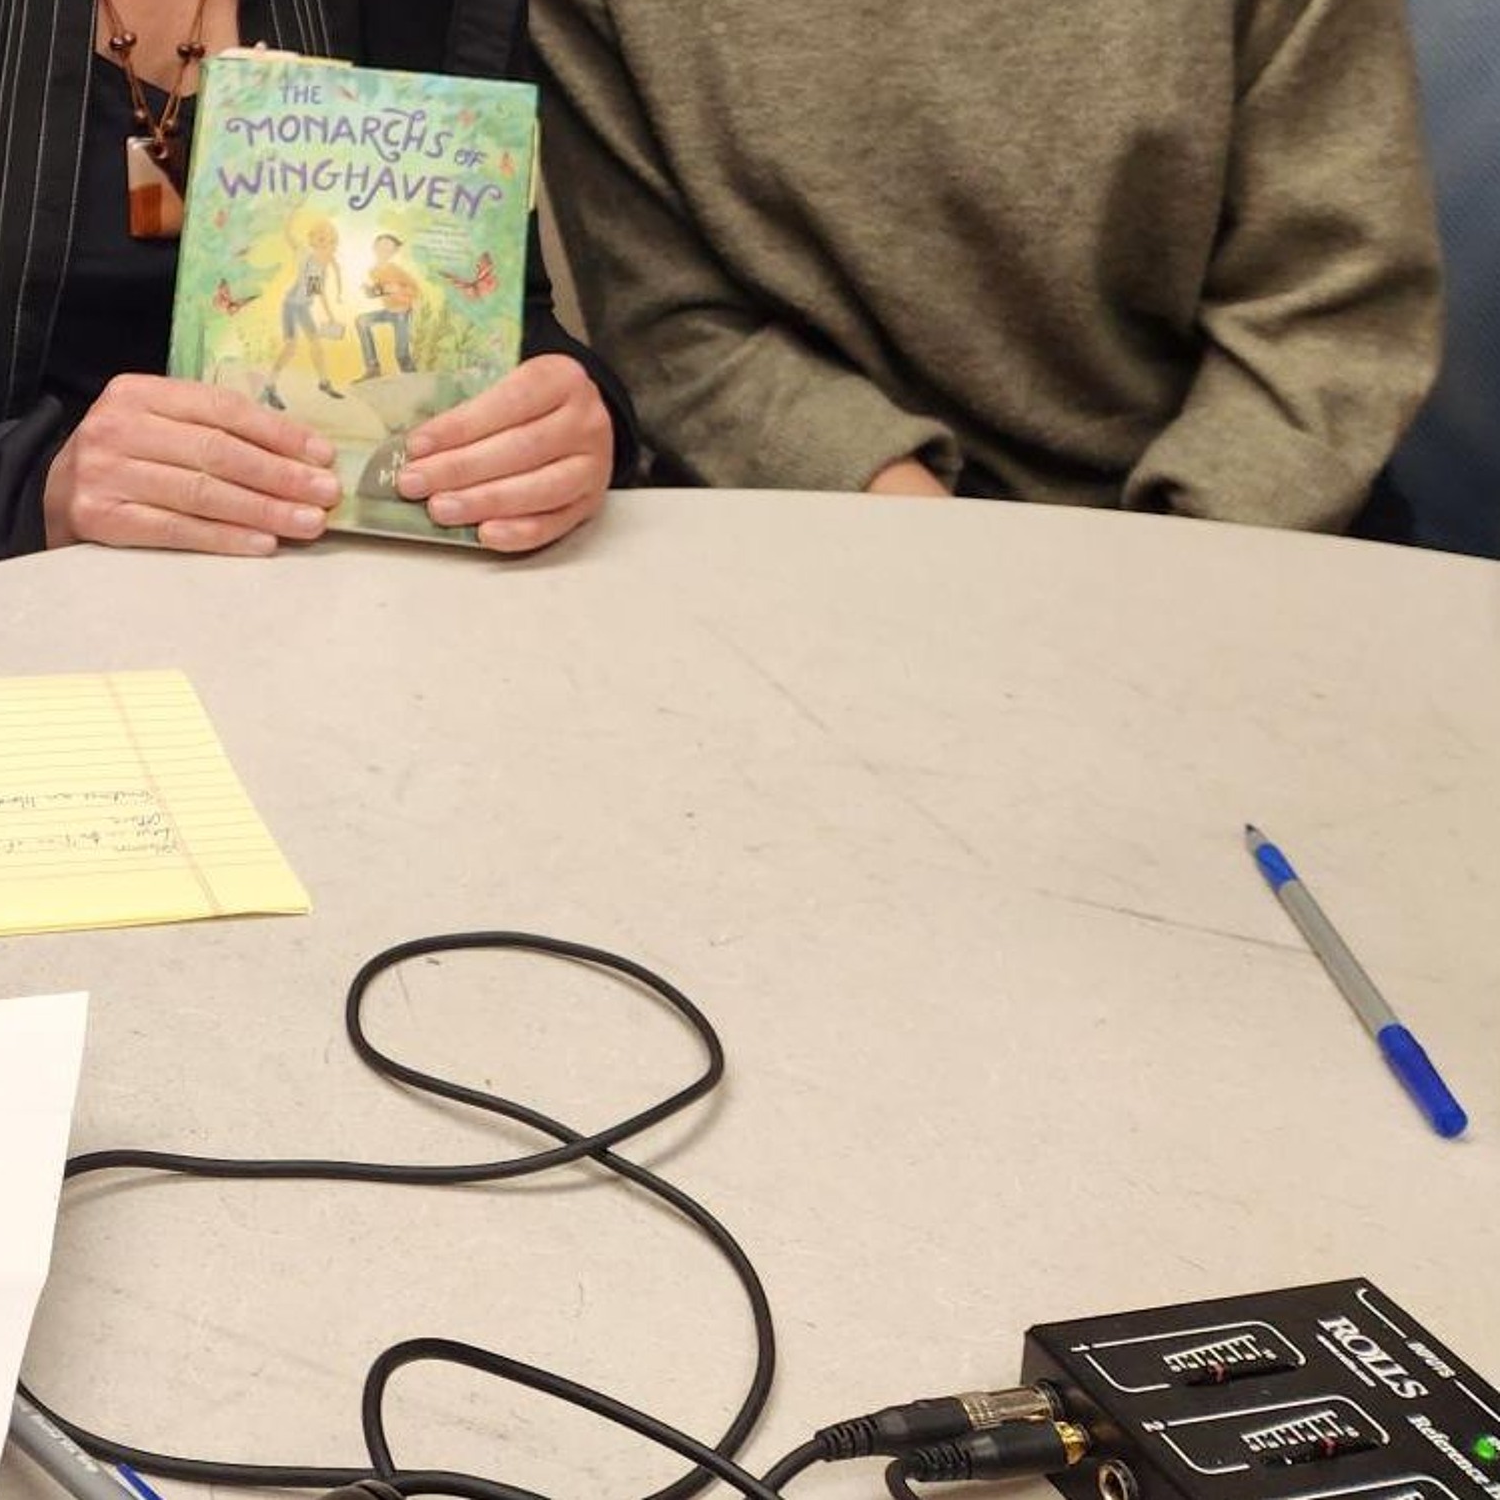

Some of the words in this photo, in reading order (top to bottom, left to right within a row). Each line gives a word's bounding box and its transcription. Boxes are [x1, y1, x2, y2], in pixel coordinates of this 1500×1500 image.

[280, 84, 322, 107] THE
[226, 107, 455, 164] MONARCHS
[453, 148, 488, 168] OF
[217, 156, 503, 220] WINGHAVEN
[1316, 1314, 1430, 1400] ROLLS
[1405, 1414, 1491, 1485] Reference
